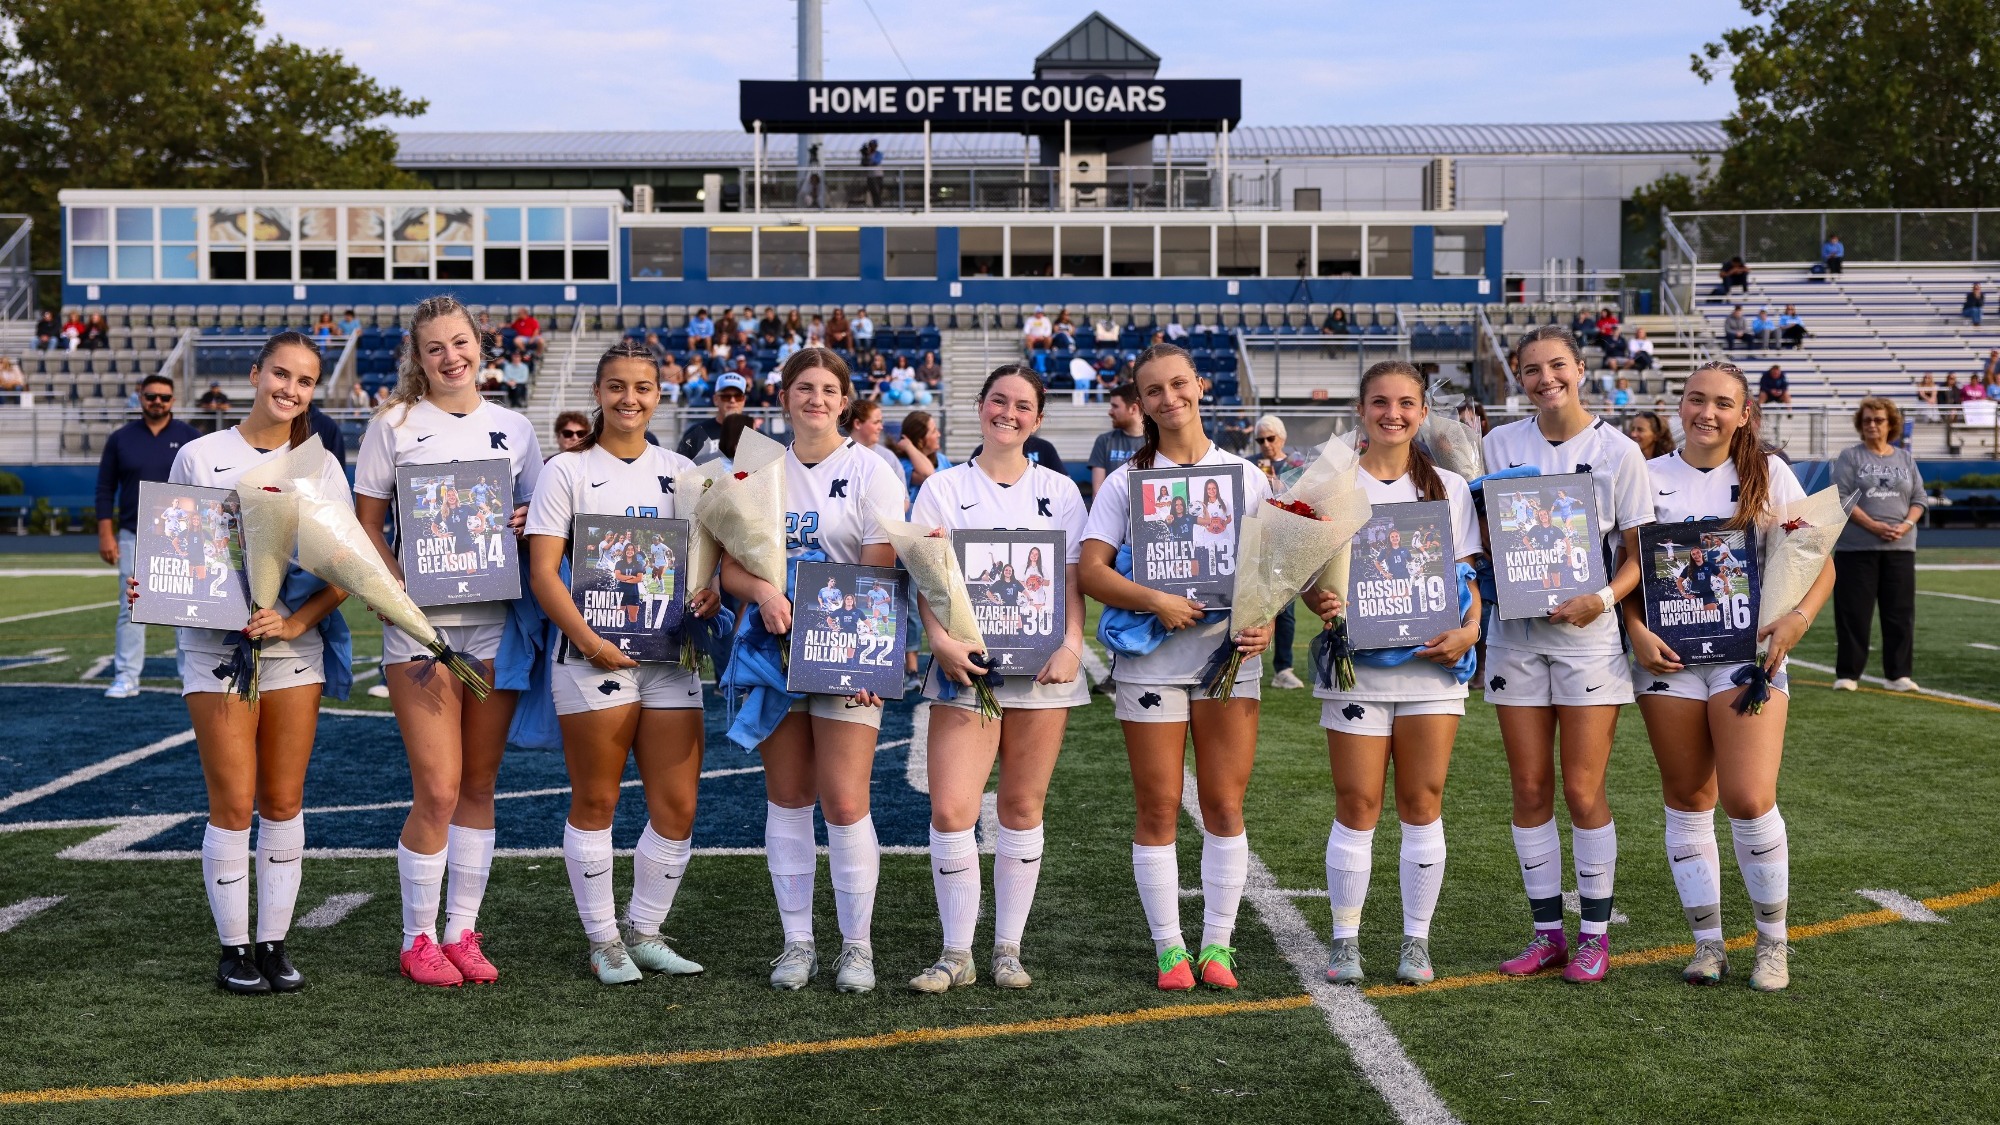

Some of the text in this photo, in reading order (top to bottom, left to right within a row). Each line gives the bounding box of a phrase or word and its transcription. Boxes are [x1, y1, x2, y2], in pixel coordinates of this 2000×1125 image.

[809, 85, 1167, 113] HOME OF THE COUGARS
[1858, 463, 1910, 483] KEAN
[1866, 487, 1900, 500] Cougars
[416, 536, 457, 556] CARLY
[476, 533, 506, 569] 14
[1146, 541, 1196, 561] ASHLEY
[1205, 538, 1236, 576] 13
[150, 555, 190, 577] KIERA
[417, 552, 478, 574] GLEASON
[1505, 548, 1564, 567] KAYDENCE
[1570, 546, 1590, 583] 9
[209, 562, 228, 598] 2
[1146, 559, 1193, 580] BAKER
[1507, 564, 1549, 582] OAKLEY
[148, 573, 194, 595] QUINN
[1356, 578, 1413, 600] CASSIDY
[1414, 575, 1447, 612] 19
[584, 590, 625, 610] EMILY
[1358, 596, 1413, 618] BOASSO
[1659, 597, 1704, 614] MORGAN
[1718, 592, 1751, 630] 16
[583, 606, 626, 628] PINHO
[642, 594, 670, 630] 17
[1020, 606, 1053, 636] 30
[1660, 608, 1721, 627] NAPOLITANO
[805, 629, 857, 649] ALLISON
[803, 645, 848, 664] DILLON
[858, 635, 894, 667] 22
